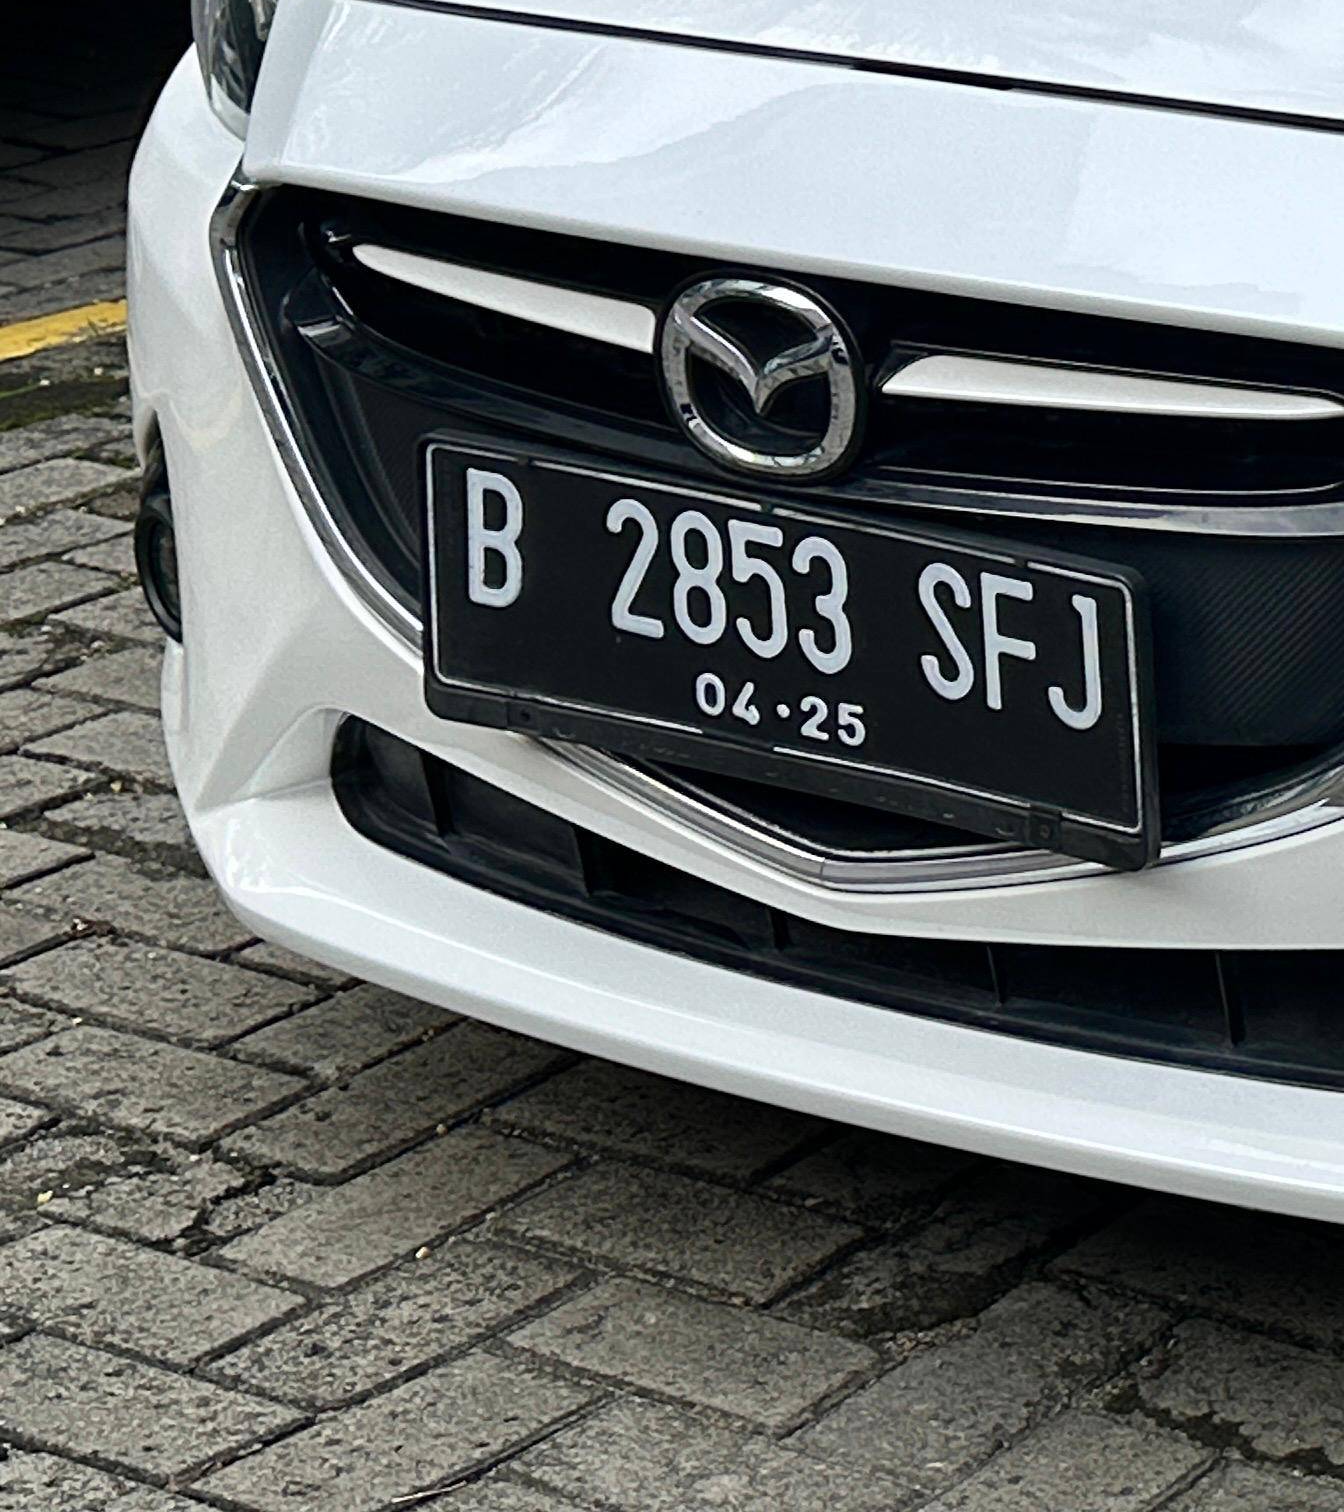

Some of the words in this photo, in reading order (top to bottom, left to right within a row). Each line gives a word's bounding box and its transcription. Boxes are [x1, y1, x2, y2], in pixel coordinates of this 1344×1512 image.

[466, 468, 523, 608] B
[606, 498, 853, 675] 2853
[918, 562, 1103, 730] SFJ
